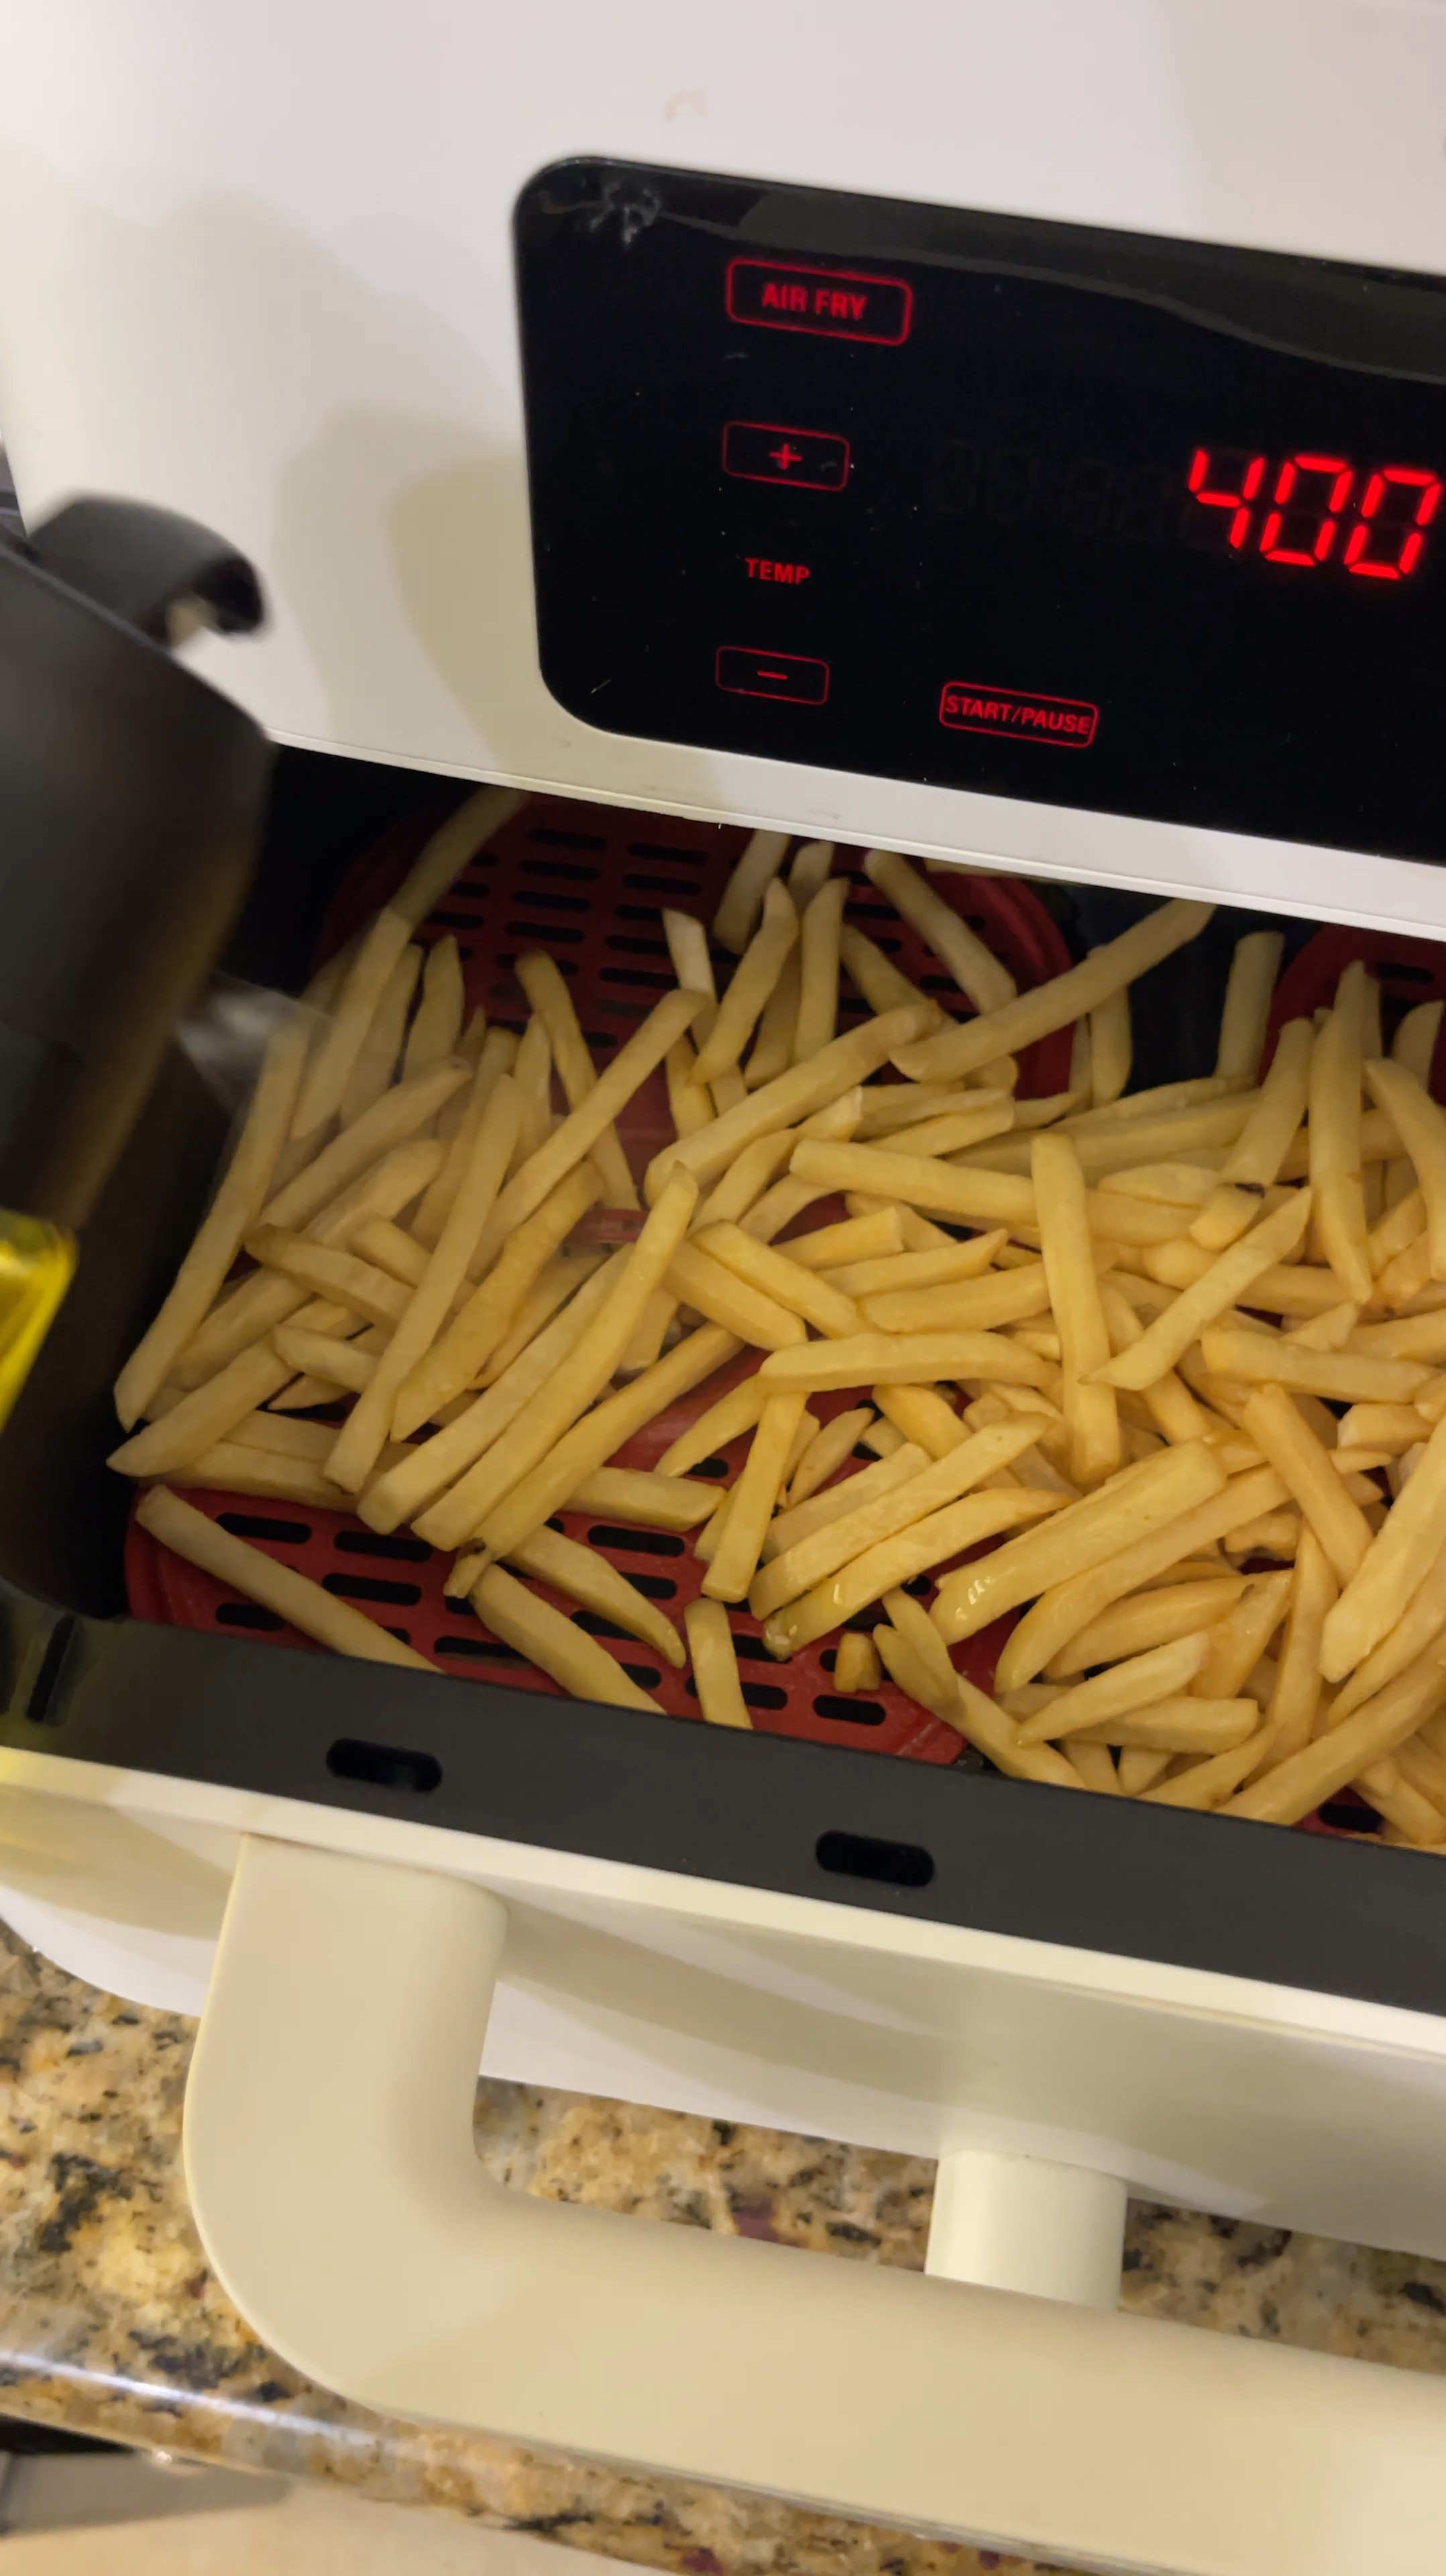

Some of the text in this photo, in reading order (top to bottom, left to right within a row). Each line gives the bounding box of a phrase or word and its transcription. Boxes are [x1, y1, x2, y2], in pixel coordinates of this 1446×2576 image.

[761, 282, 867, 321] AIR FRY
[1186, 447, 1442, 582] 400
[745, 557, 811, 584] TEMP
[945, 694, 1092, 735] START/PAUSE
